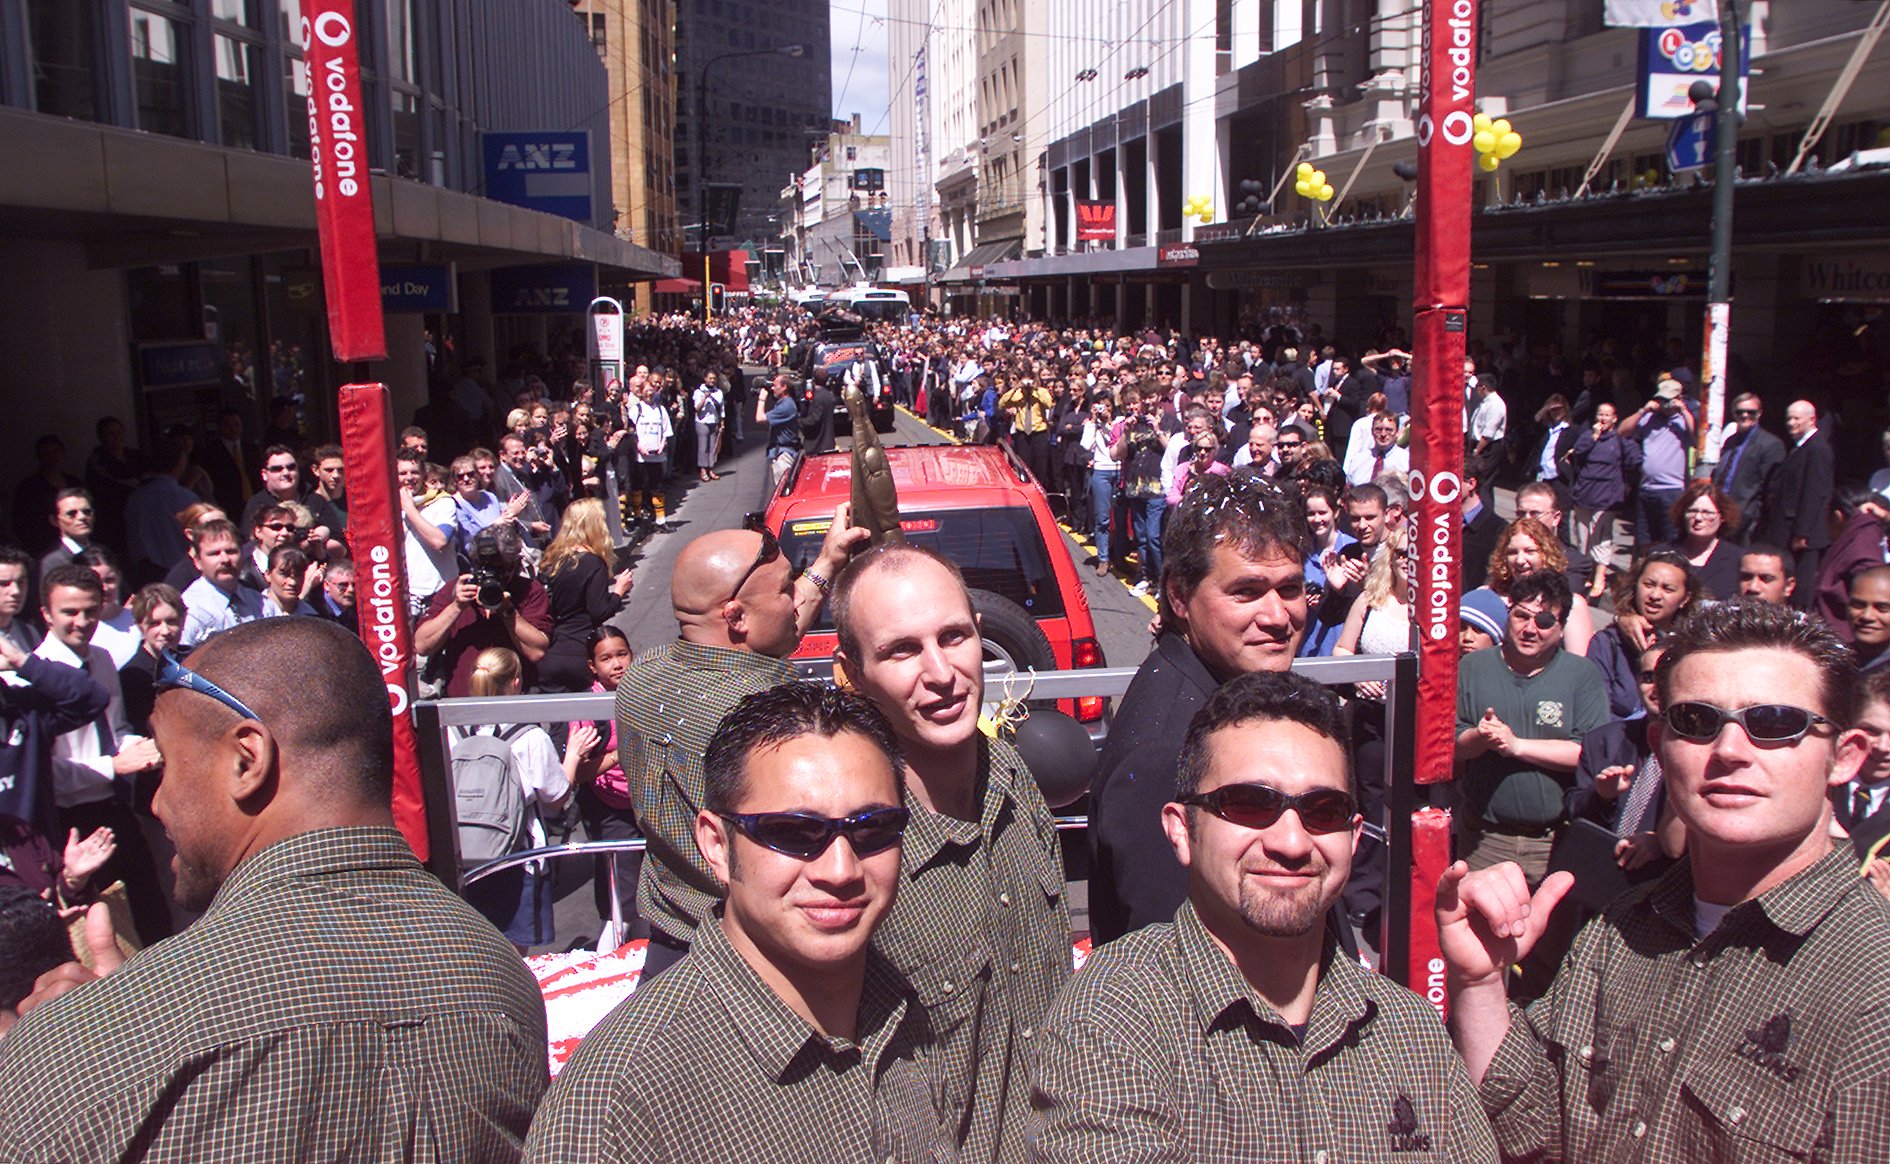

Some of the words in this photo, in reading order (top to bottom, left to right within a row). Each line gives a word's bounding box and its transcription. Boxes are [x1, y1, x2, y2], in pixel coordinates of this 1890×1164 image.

[1448, 0, 1471, 101] vodafo
[1661, 31, 1722, 68] LOTT
[304, 62, 324, 199] vodafone
[325, 57, 358, 196] vodafone
[497, 143, 576, 170] ANZ
[380, 282, 400, 295] nd
[404, 281, 429, 298] Day
[514, 287, 570, 306] ANZ
[1406, 511, 1419, 618] vodafon
[1431, 513, 1452, 639] vodafone
[370, 545, 398, 675] vodafone
[1427, 957, 1445, 1020] one
[1734, 1039, 1800, 1083] LIONS
[1391, 1134, 1430, 1152] LIONS
